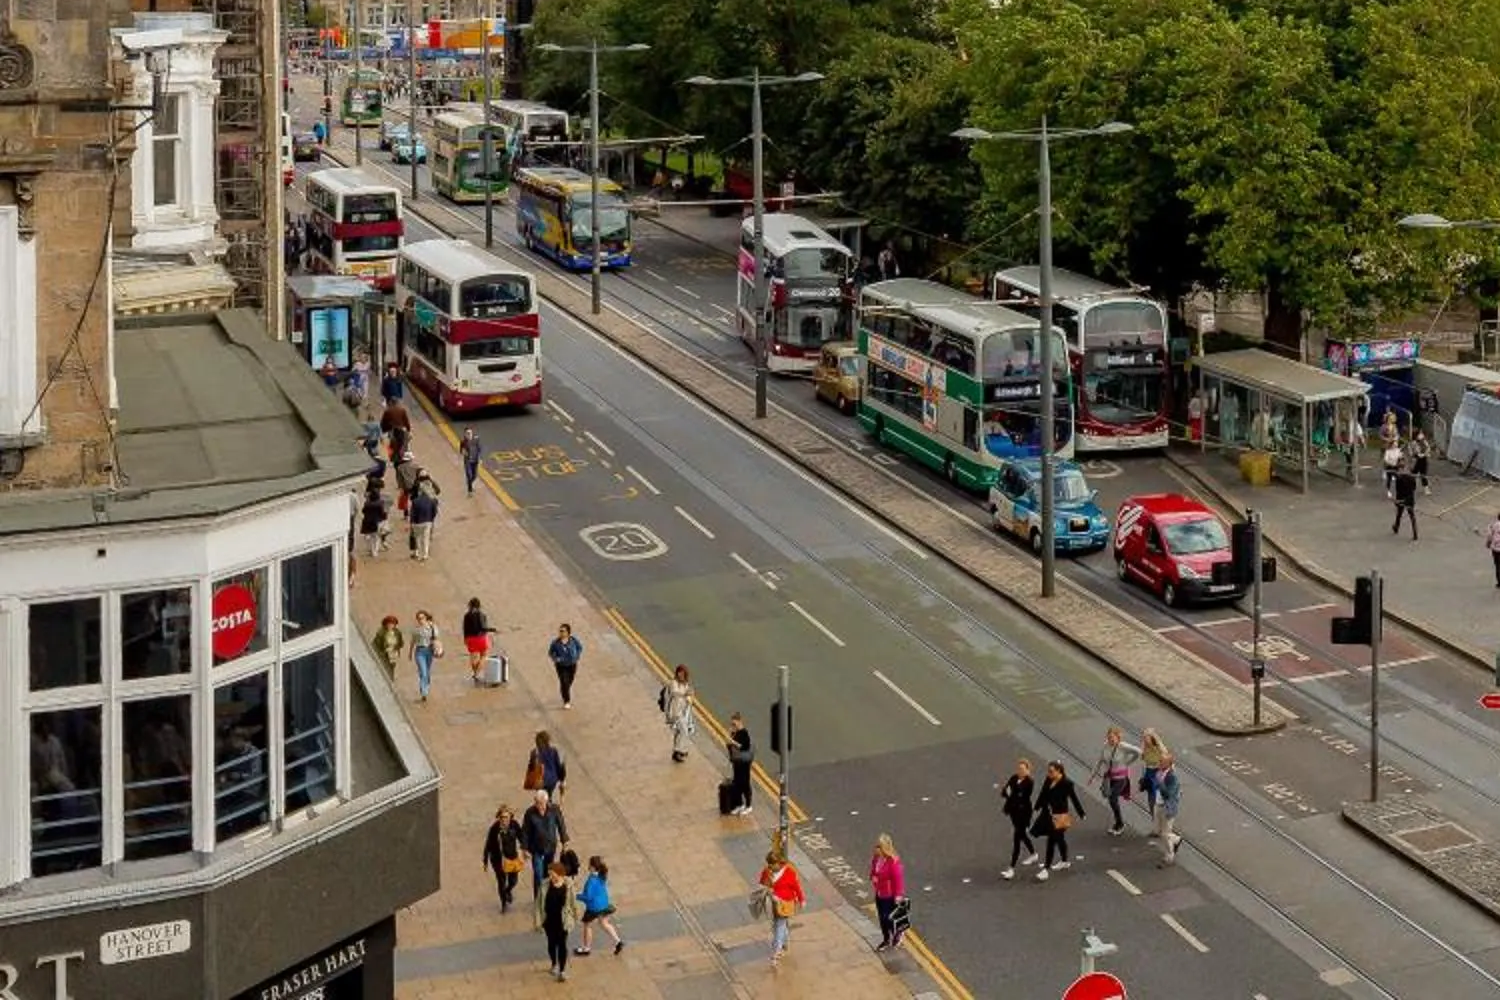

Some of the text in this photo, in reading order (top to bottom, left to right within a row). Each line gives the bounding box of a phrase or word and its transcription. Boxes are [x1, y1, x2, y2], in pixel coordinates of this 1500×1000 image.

[595, 531, 651, 551] 20
[211, 608, 253, 633] COSTA
[107, 923, 183, 949] HANOVER
[116, 940, 171, 960] STREET
[261, 963, 322, 1000] FRASER
[324, 938, 366, 974] HART
